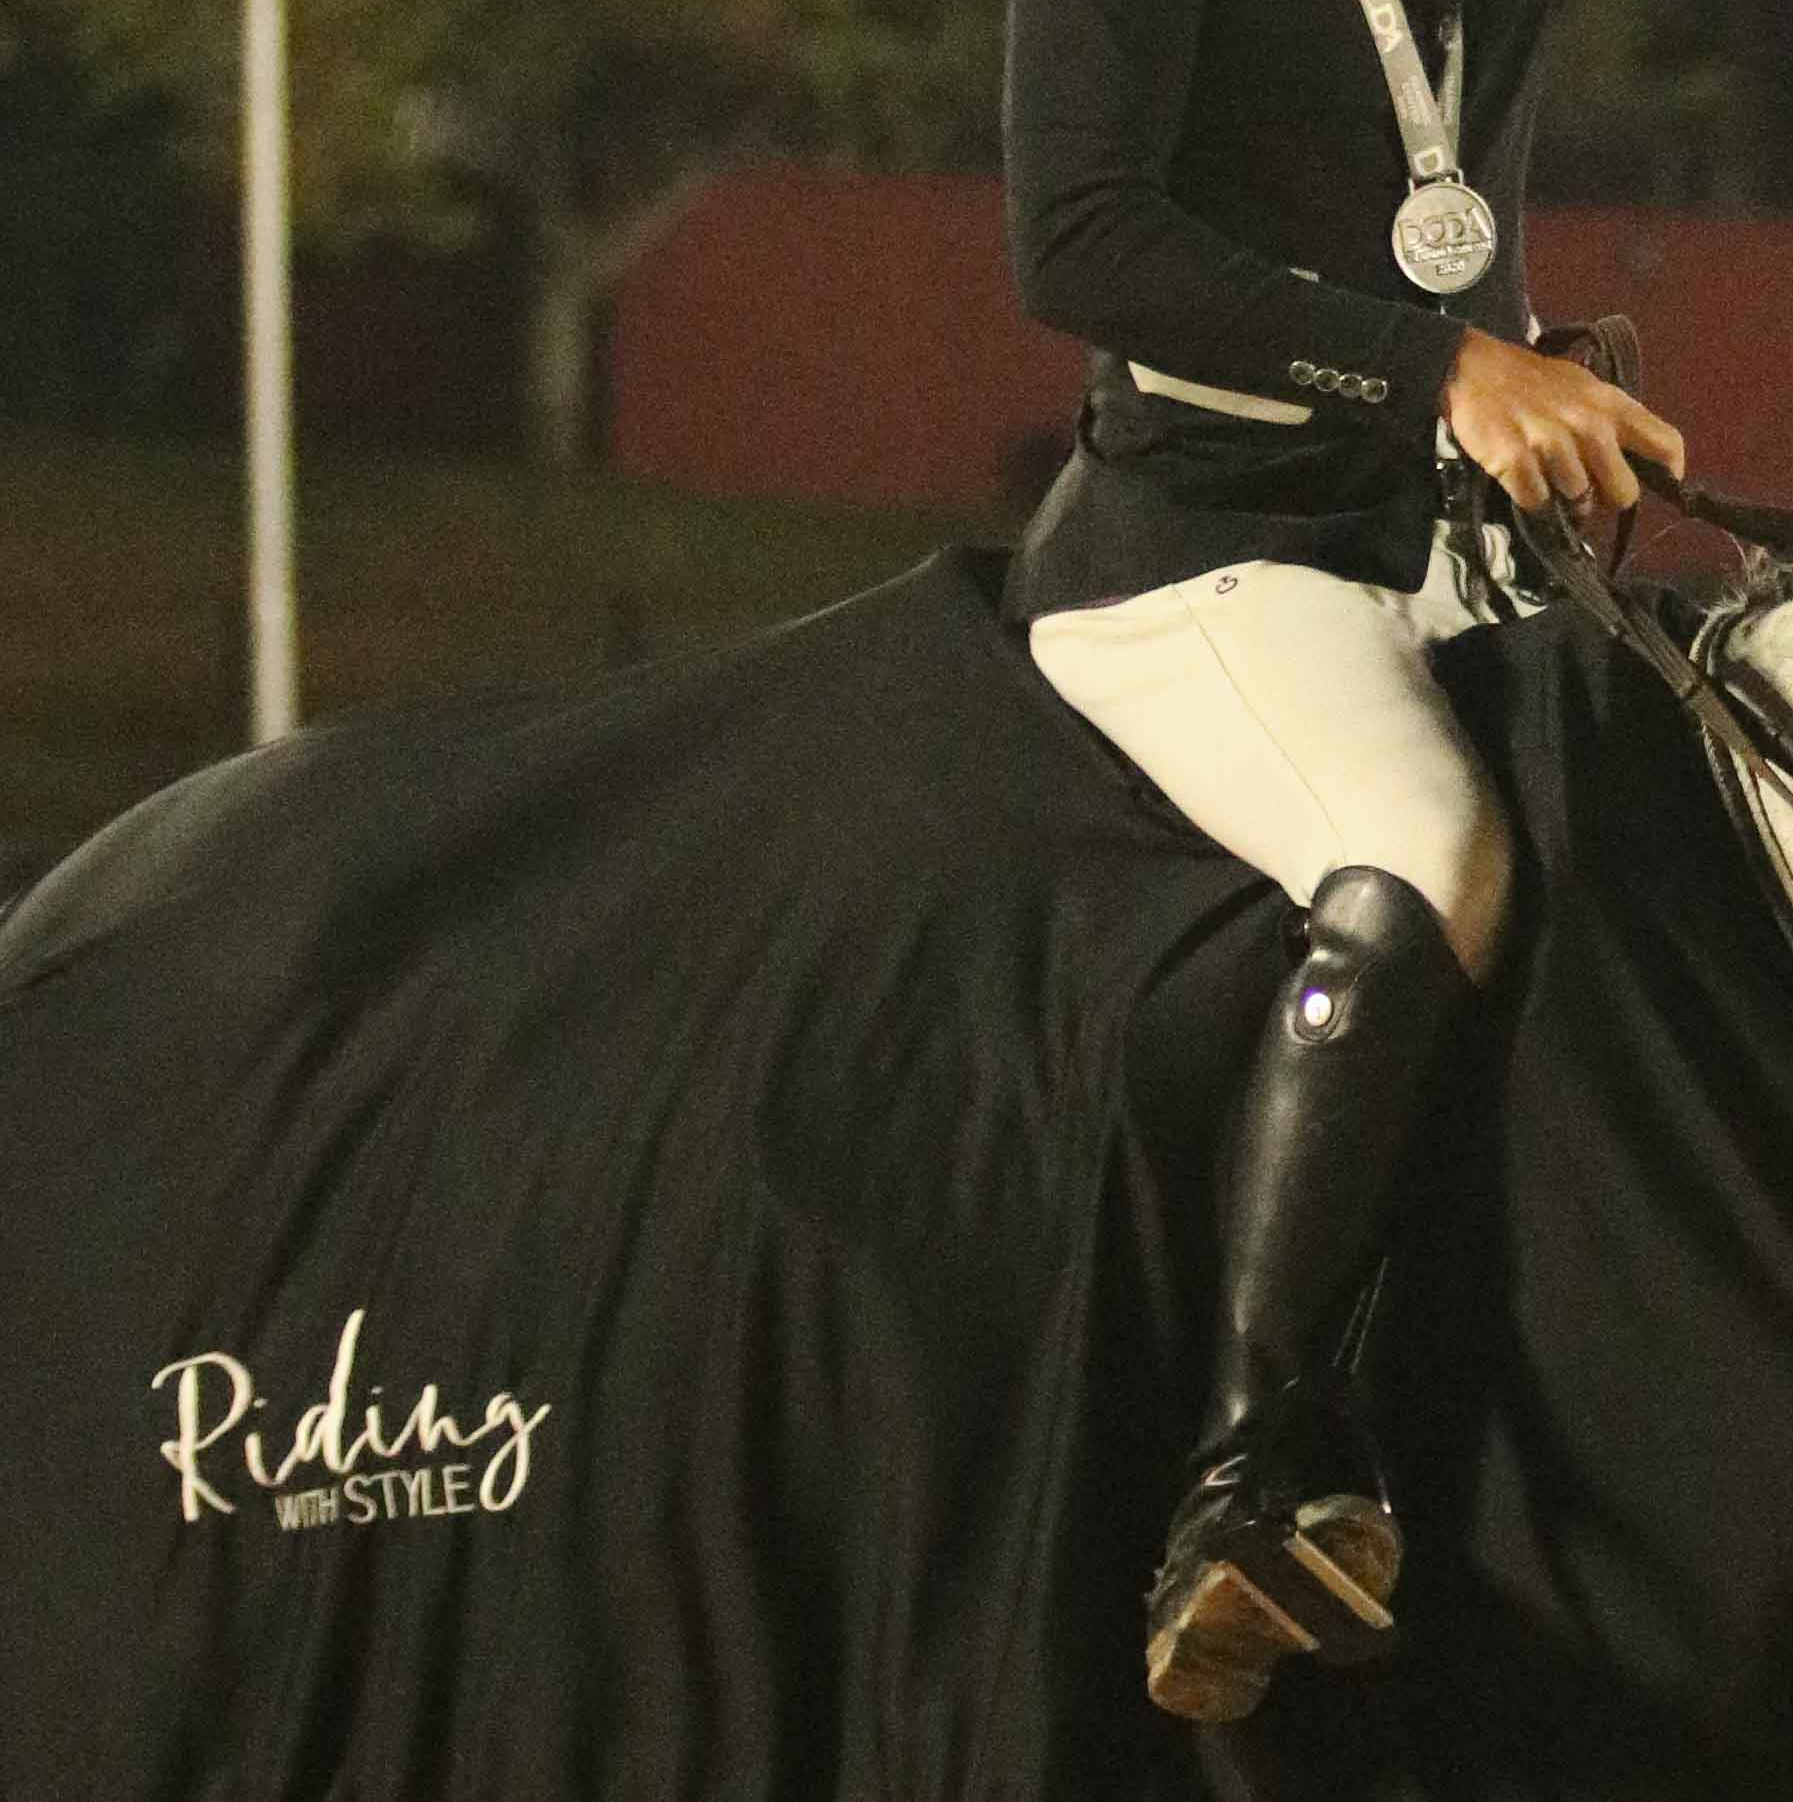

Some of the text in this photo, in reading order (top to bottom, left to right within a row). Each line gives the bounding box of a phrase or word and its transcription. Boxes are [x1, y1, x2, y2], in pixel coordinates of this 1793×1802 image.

[151, 1308, 553, 1523] Riding
[275, 1463, 475, 1532] WITH STYLE
